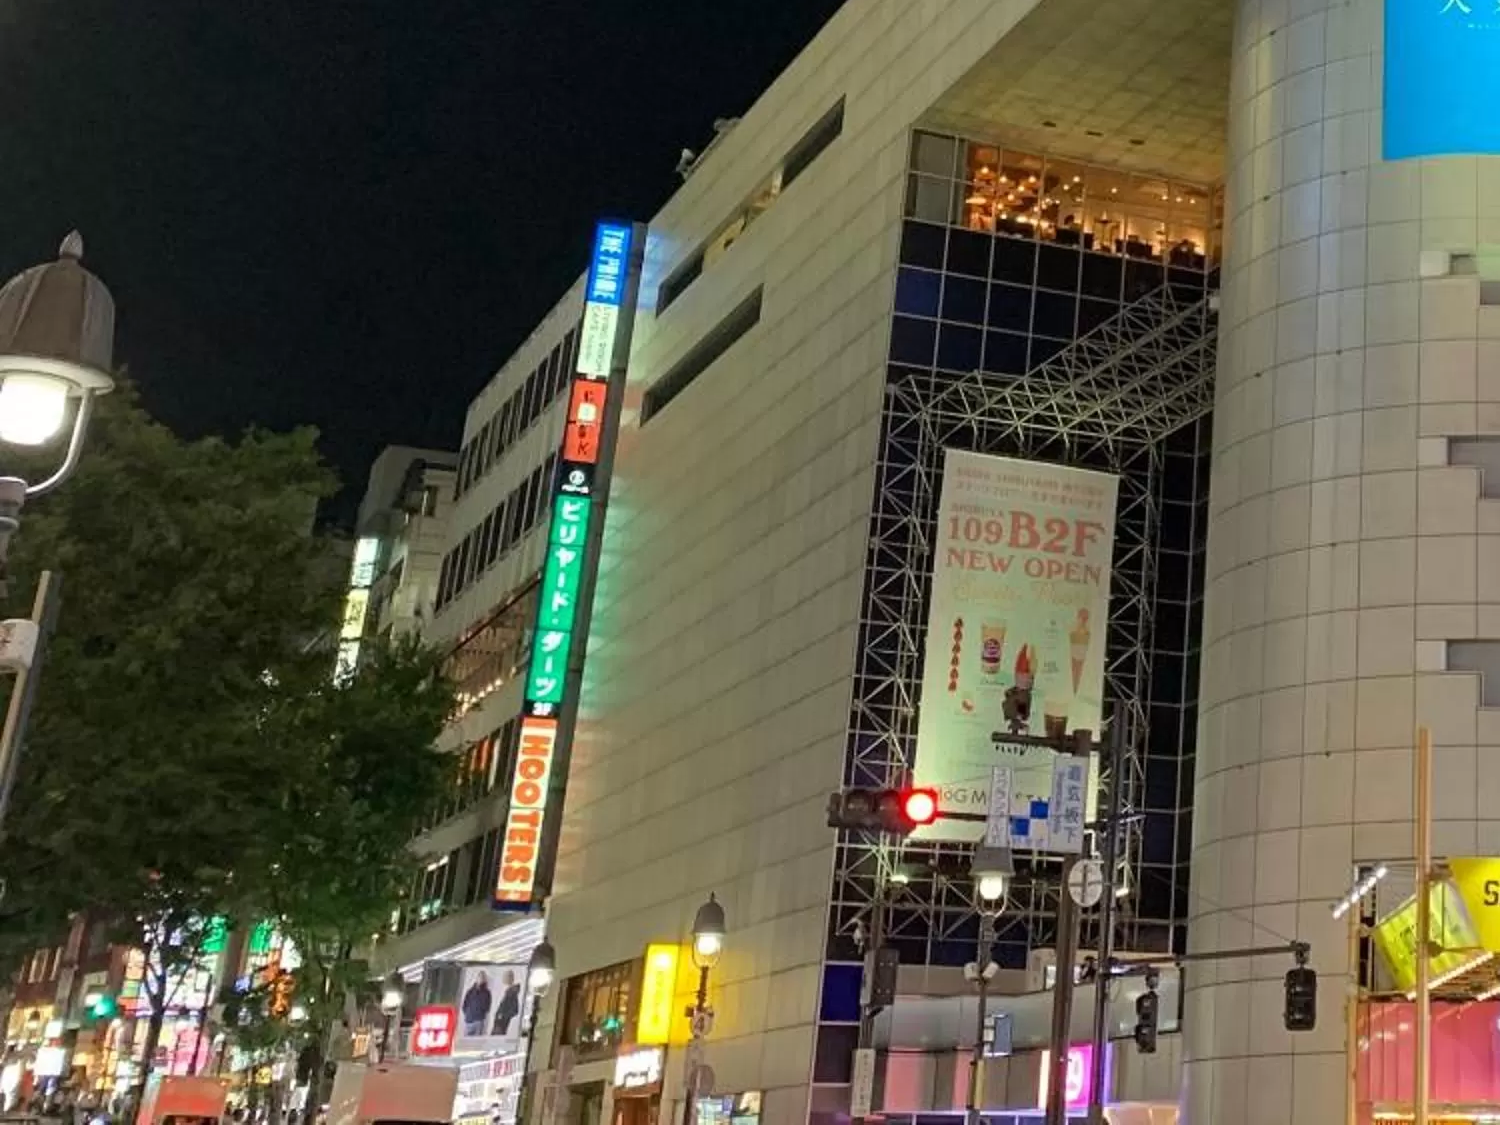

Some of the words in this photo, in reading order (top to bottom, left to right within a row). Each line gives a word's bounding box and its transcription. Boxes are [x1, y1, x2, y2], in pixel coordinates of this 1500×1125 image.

[948, 514, 1003, 546] 109
[1008, 510, 1107, 558] B2F
[946, 546, 1016, 575] NEW
[1024, 556, 1102, 587] OPEN
[502, 734, 553, 886] HOOTERS
